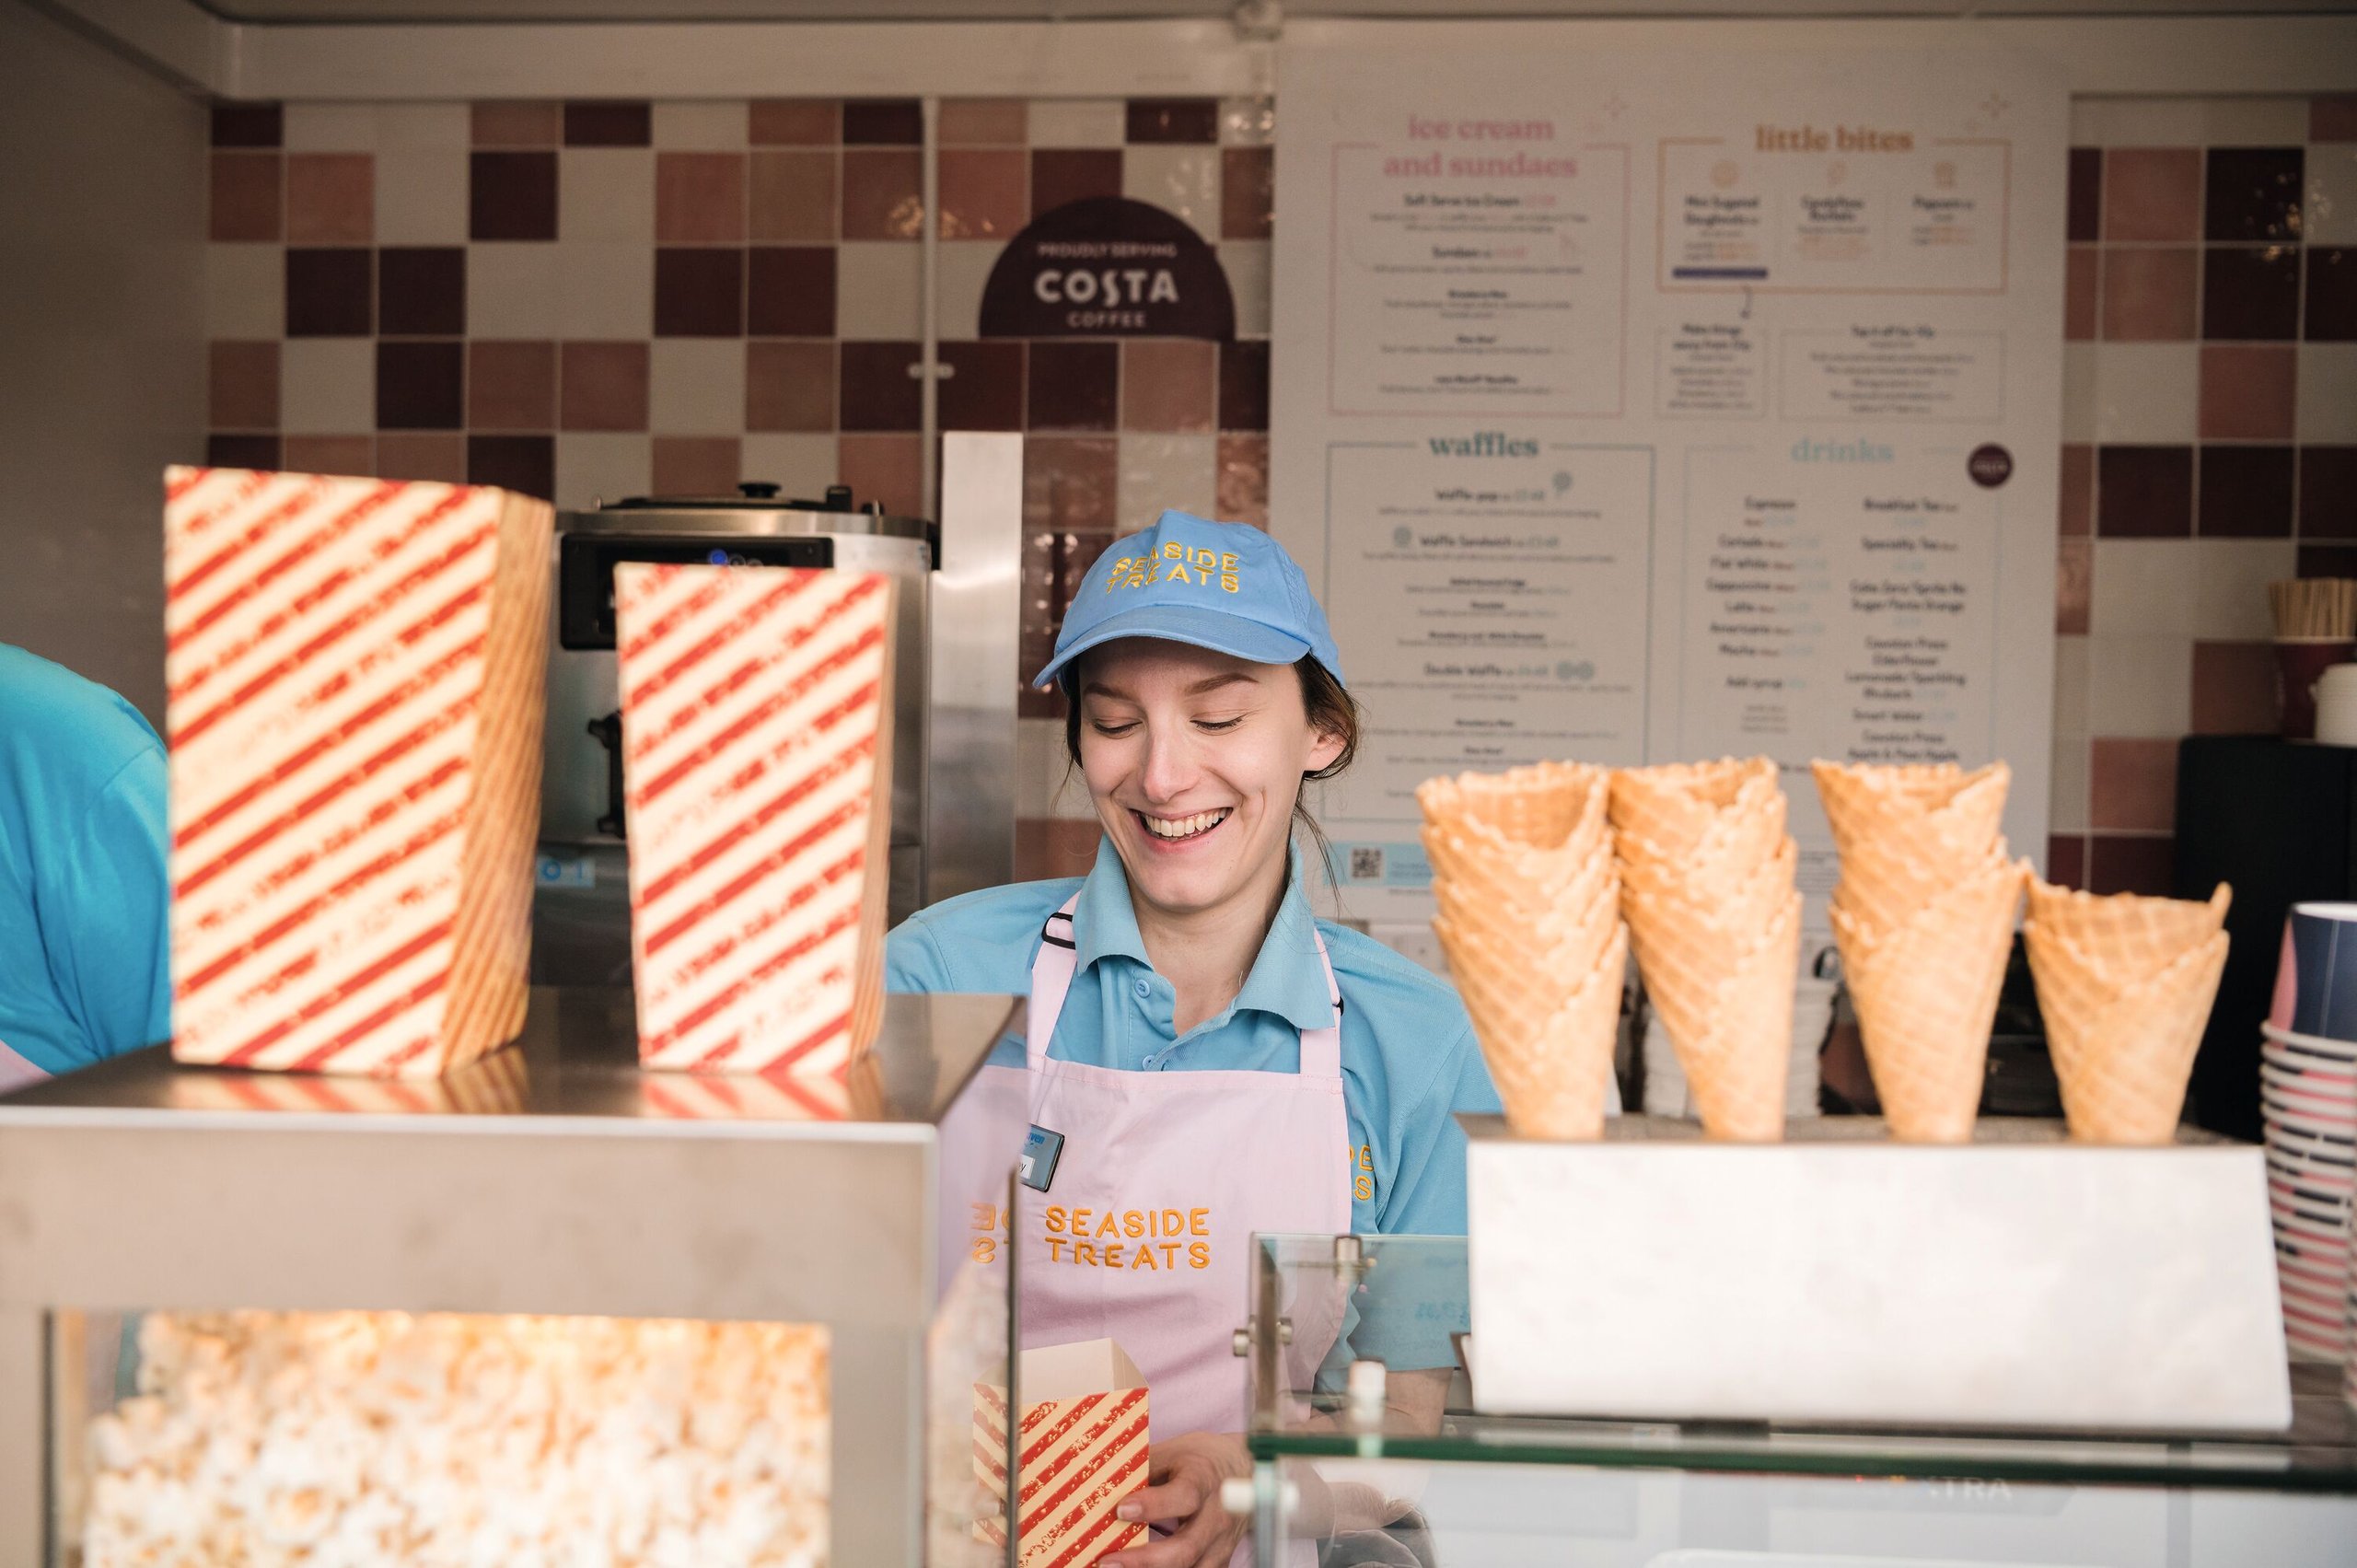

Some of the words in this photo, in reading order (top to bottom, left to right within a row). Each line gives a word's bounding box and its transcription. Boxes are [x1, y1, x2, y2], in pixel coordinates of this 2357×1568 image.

[1410, 114, 1449, 140] ice
[1458, 118, 1553, 140] cream
[1756, 124, 1829, 151] little
[1837, 124, 1913, 151] bites
[1385, 153, 1441, 177] and
[1450, 153, 1577, 178] sundaes
[1037, 241, 1106, 258] PROUDLY
[1110, 241, 1178, 258] SERVING
[1034, 269, 1178, 308] COSTA
[1066, 310, 1146, 328] COFFEE
[1430, 432, 1538, 457] waffles
[1792, 439, 1893, 461] drinks
[1111, 541, 1239, 576] SEASIDE
[1105, 563, 1240, 594] TREATS
[1045, 1204, 1210, 1238] SEASIDE
[1045, 1236, 1211, 1271] TREATS
